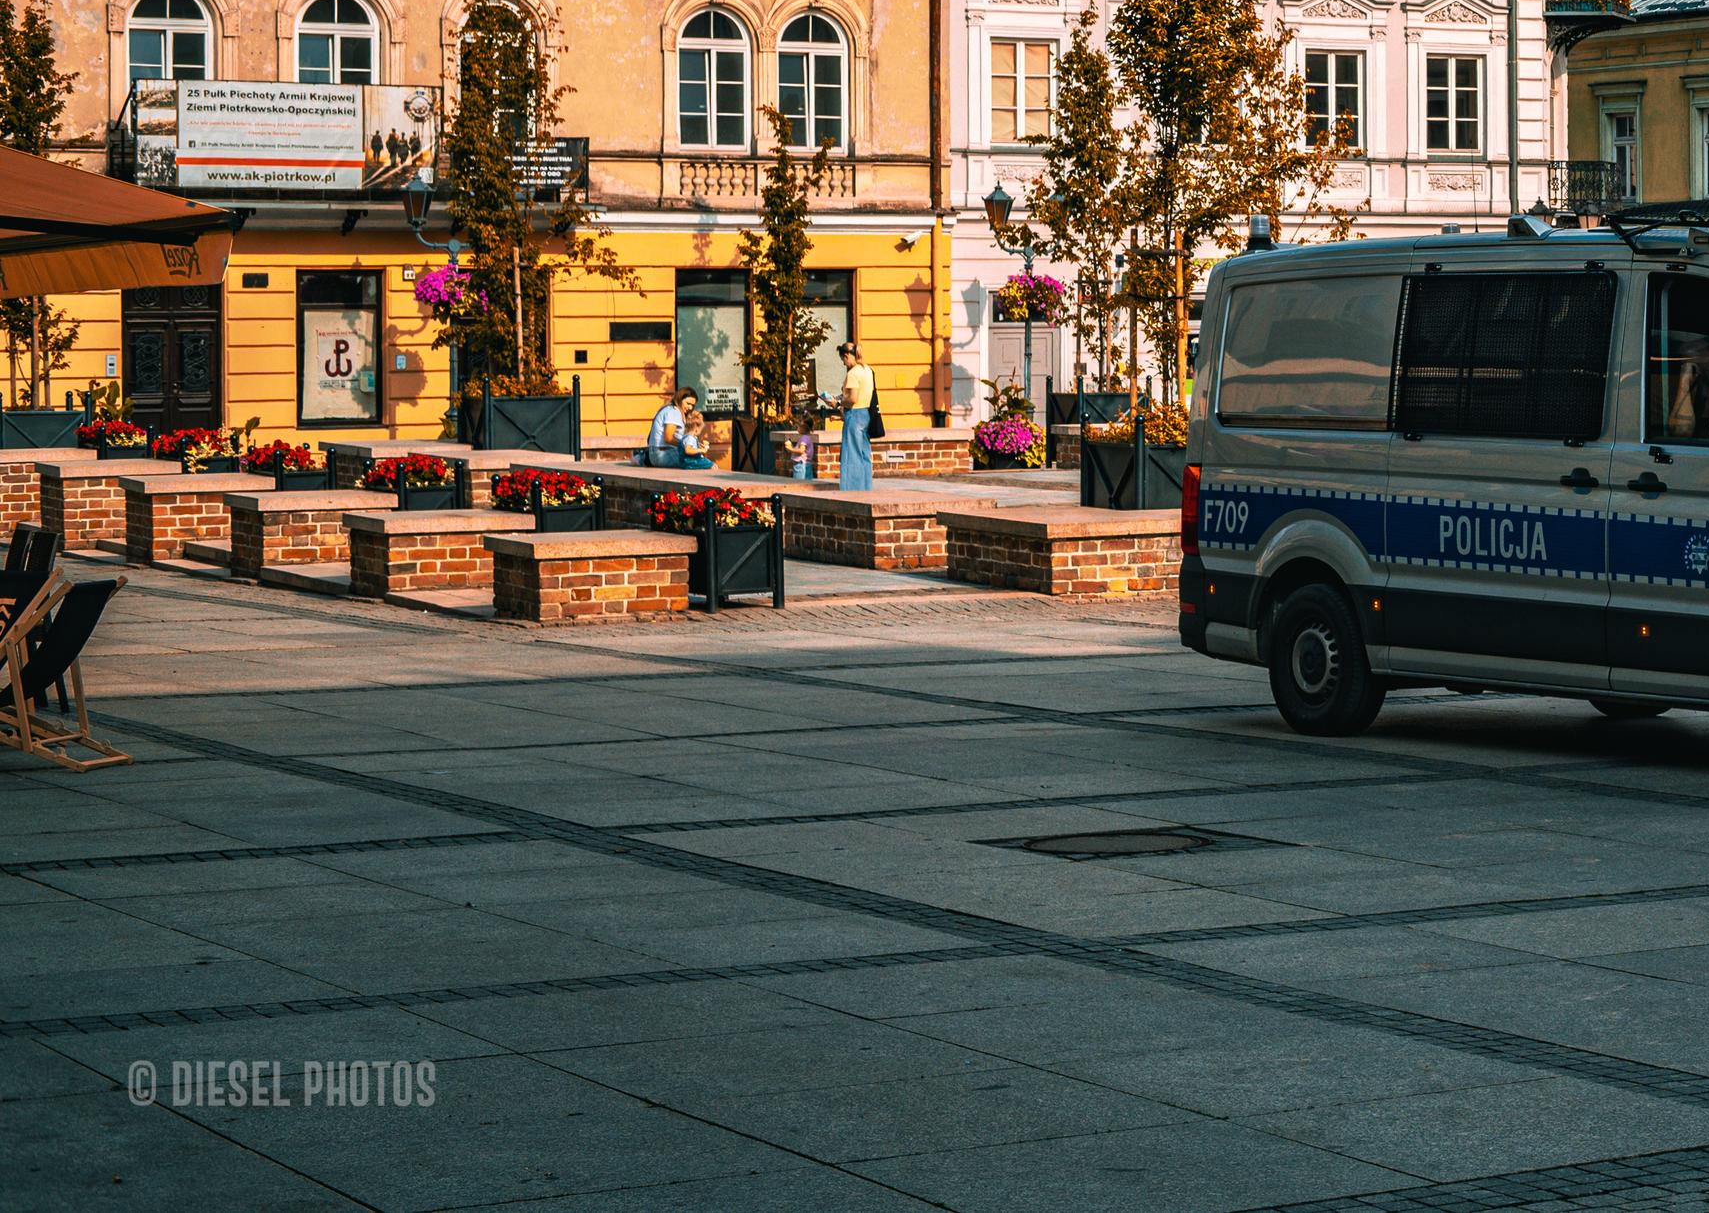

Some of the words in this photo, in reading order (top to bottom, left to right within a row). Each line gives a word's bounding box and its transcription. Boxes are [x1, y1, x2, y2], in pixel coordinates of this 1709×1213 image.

[187, 89, 200, 98] 25
[204, 89, 226, 99] Pułk
[230, 90, 275, 100] Piechoty
[279, 92, 306, 101] Armii
[310, 93, 355, 103] Krajowej
[186, 103, 216, 112] Ziemi
[220, 104, 356, 117] Piotrkowsko-Opoczyńskiej
[207, 171, 336, 182] www.ak-piotrkow.pl
[1203, 500, 1249, 534] F709
[1439, 515, 1547, 561] POLICJA
